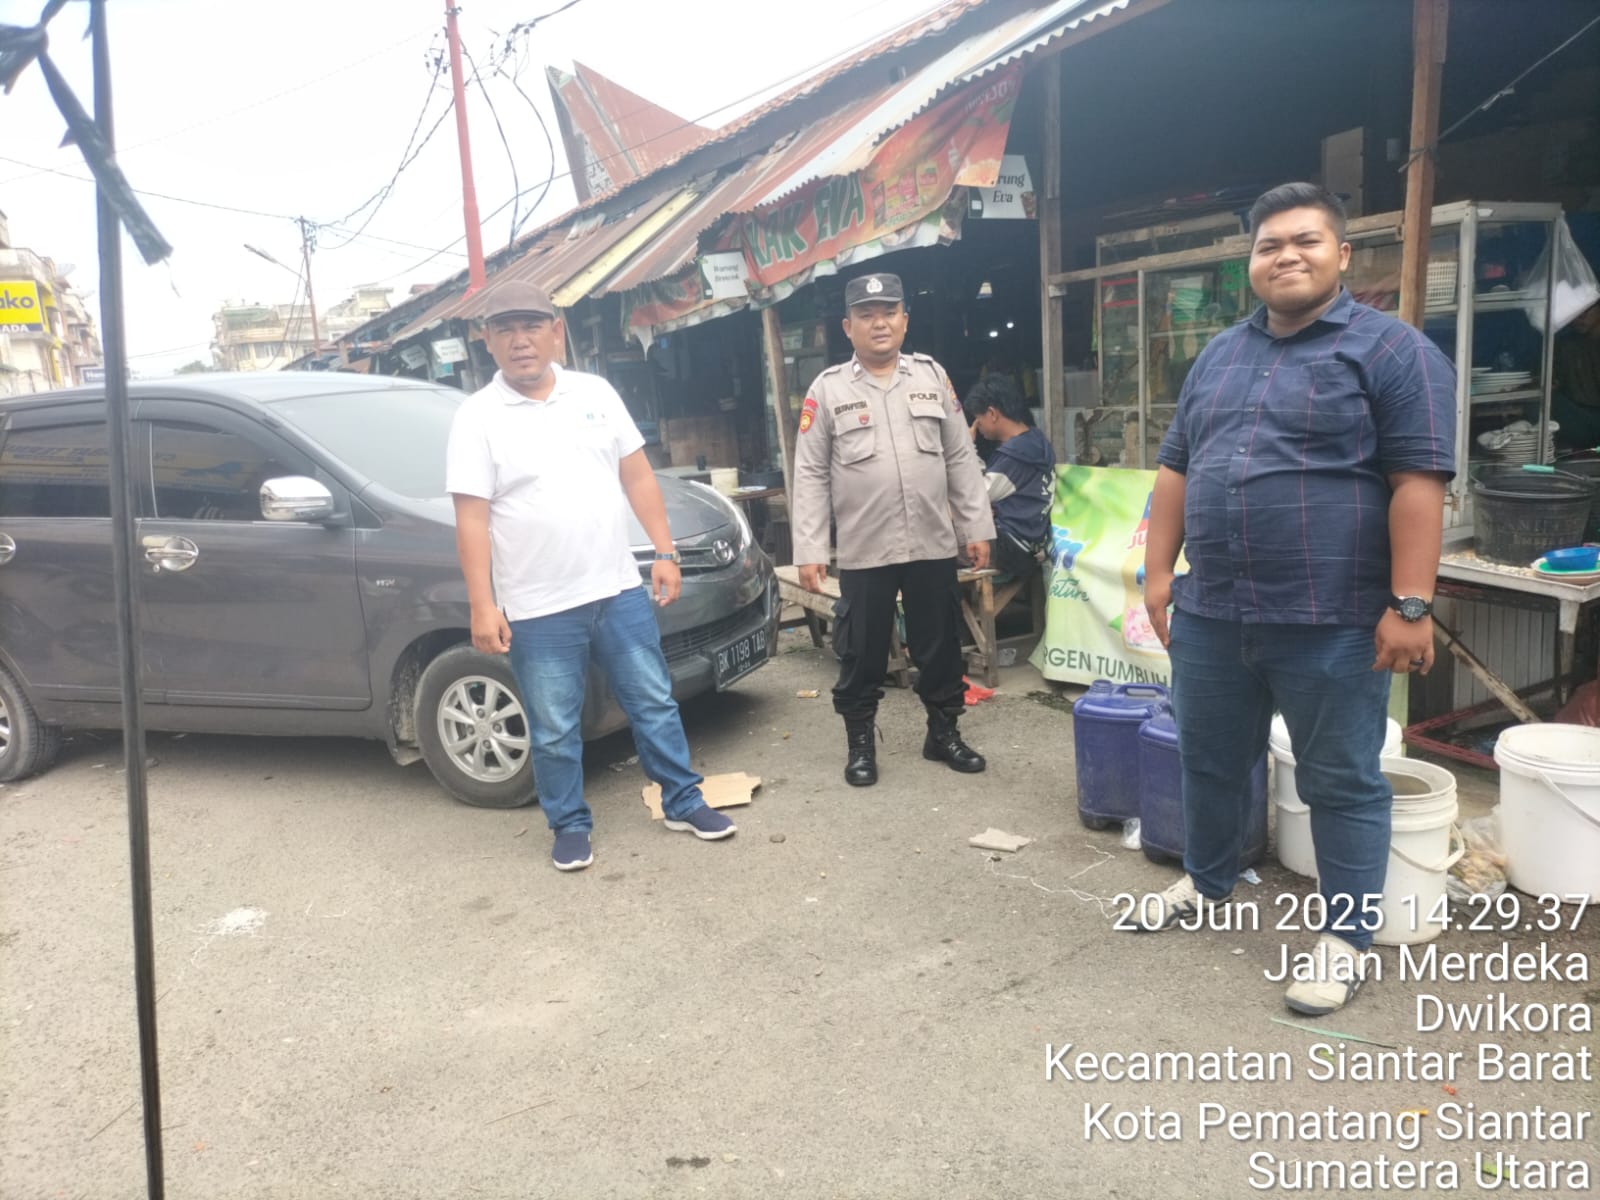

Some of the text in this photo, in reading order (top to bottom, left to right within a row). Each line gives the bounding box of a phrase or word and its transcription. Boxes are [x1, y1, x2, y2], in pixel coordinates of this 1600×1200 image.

[997, 173, 1025, 188] rung
[744, 172, 865, 269] KAK EVA
[1050, 571, 1089, 602] ature
